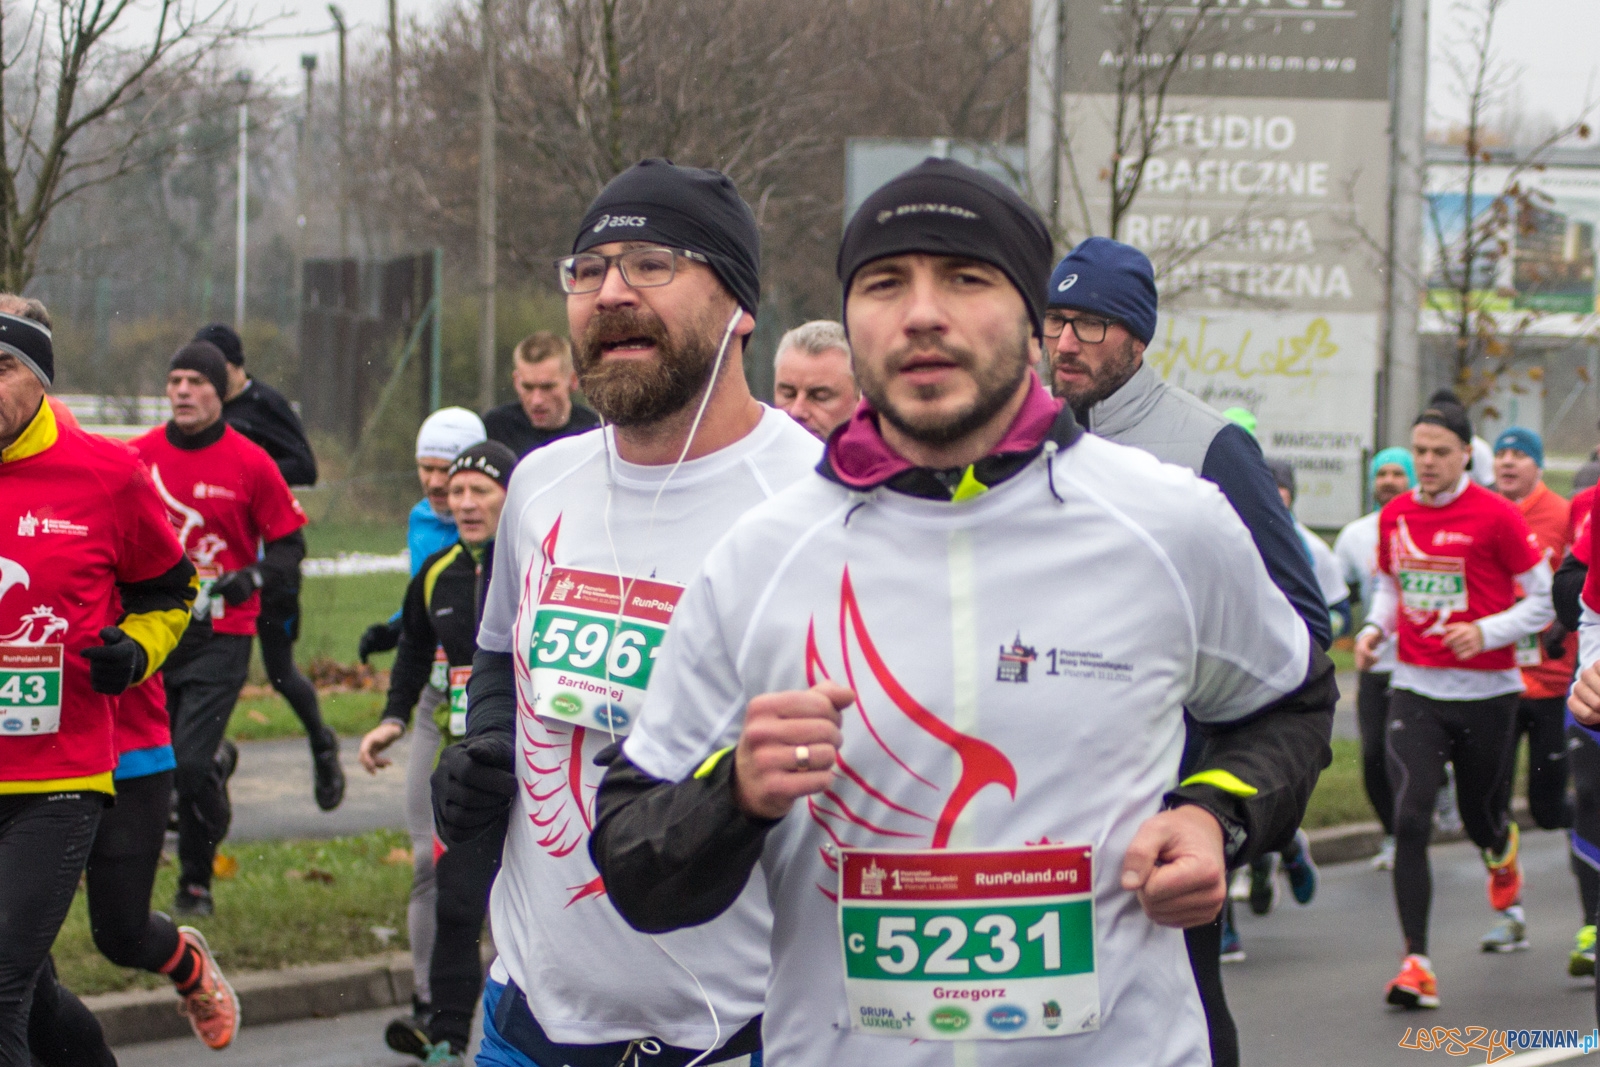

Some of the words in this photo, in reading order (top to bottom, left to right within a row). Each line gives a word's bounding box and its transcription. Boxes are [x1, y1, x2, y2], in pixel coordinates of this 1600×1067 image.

[1212, 52, 1357, 72] Reklamowa
[1153, 113, 1297, 150] STUDIO
[896, 203, 979, 218] DUNLOP
[1125, 215, 1315, 254] REKLAMA
[632, 596, 677, 612] RunPola
[531, 631, 540, 648] C
[975, 869, 1078, 885] RunPoland.org
[848, 933, 866, 953] C
[875, 911, 1062, 975] 5231
[933, 986, 1007, 1001] Grzegorz
[860, 1006, 895, 1019] GRUPA
[861, 1017, 902, 1029] LUXMED
